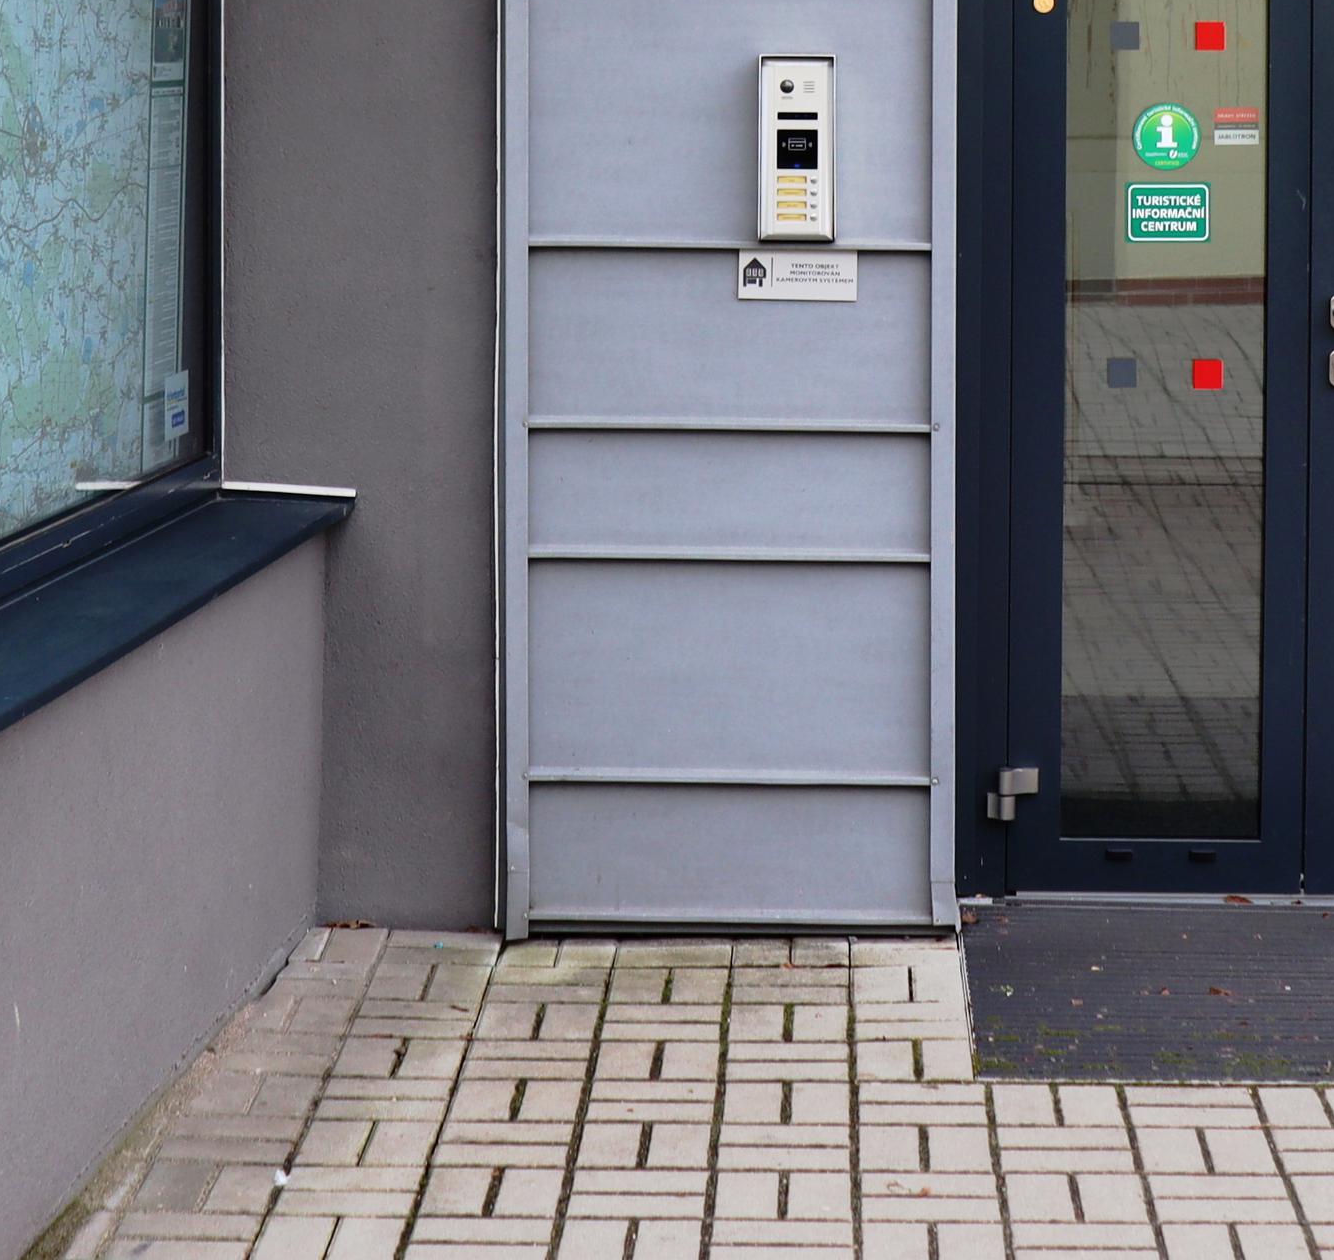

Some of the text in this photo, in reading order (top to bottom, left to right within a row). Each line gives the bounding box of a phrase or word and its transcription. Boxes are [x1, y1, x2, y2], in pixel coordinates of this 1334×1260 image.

[1136, 193, 1202, 207] TURISTICKÉ
[1132, 206, 1205, 219] INFORMAČNÍ
[1140, 221, 1197, 232] CENTRUM
